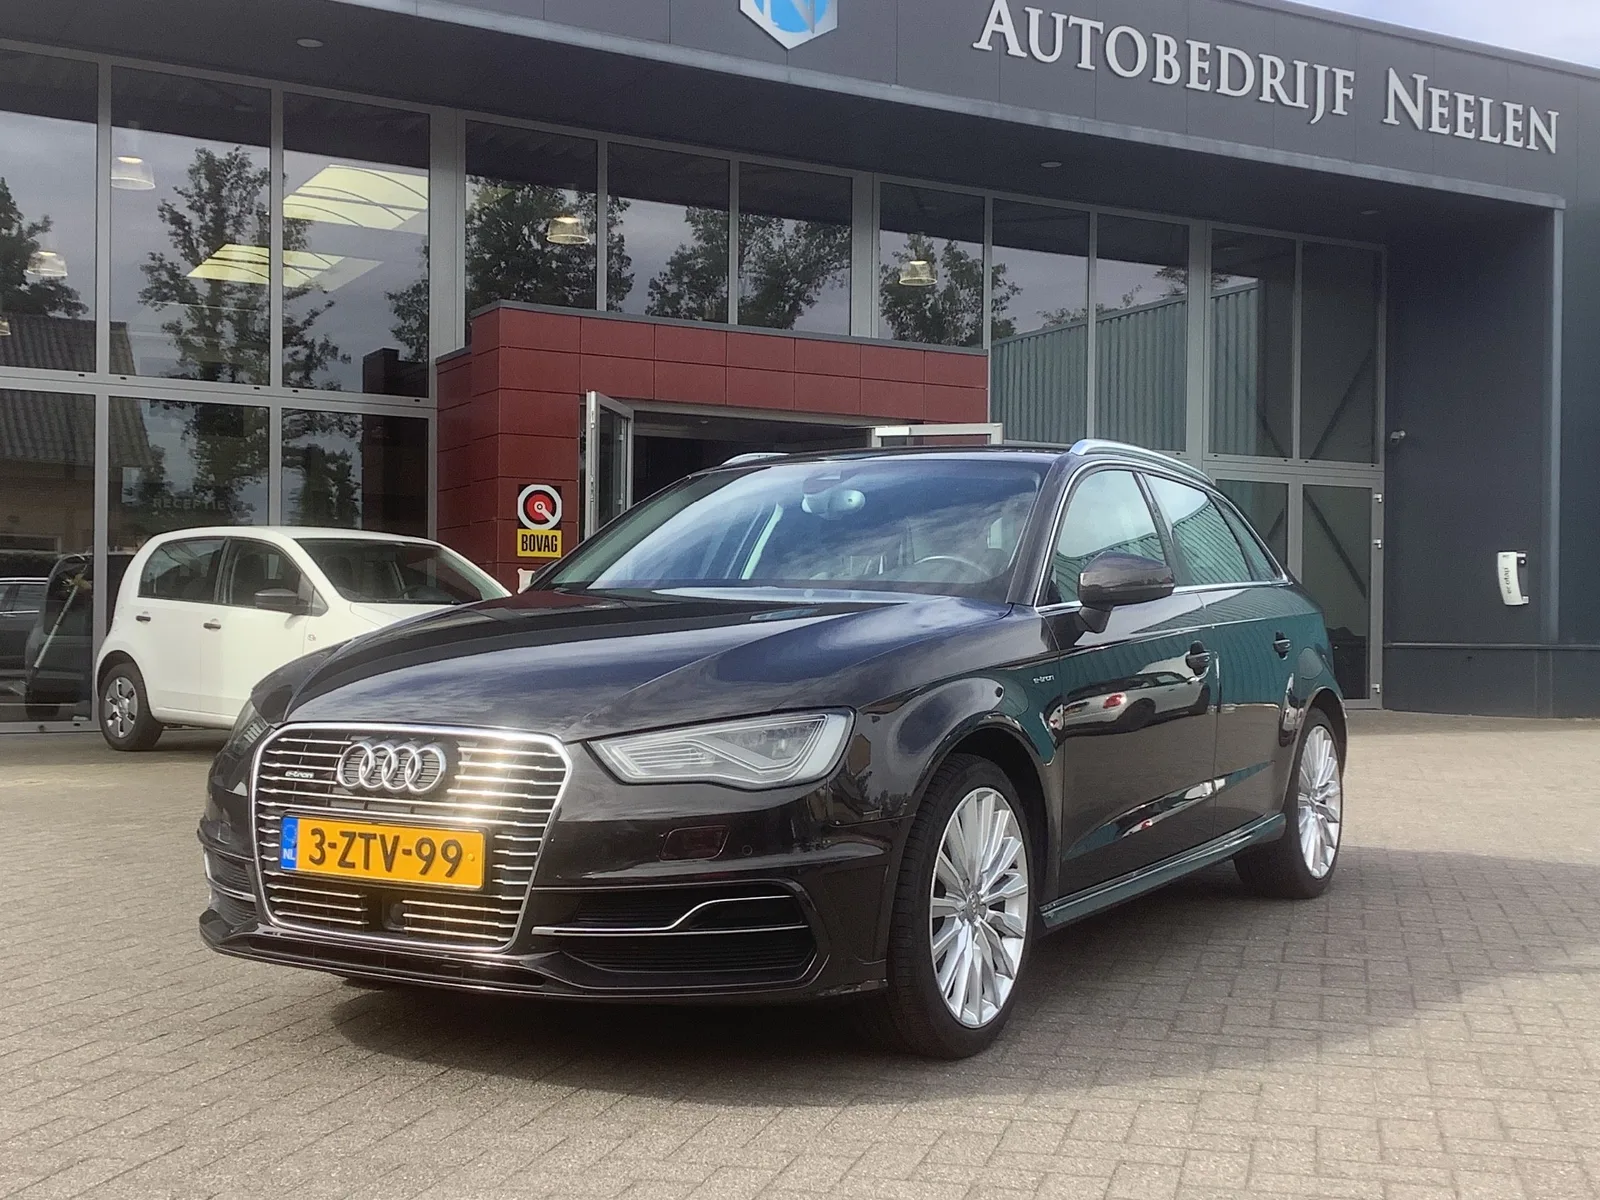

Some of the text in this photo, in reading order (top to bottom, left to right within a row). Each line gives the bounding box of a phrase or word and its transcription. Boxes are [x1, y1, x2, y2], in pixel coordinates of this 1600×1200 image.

[973, 0, 1560, 154] AUTOBEDRIJF NEELEN
[521, 534, 558, 553] BOVAG
[282, 849, 296, 861] NL
[309, 827, 463, 878] 3-ZTV-99
